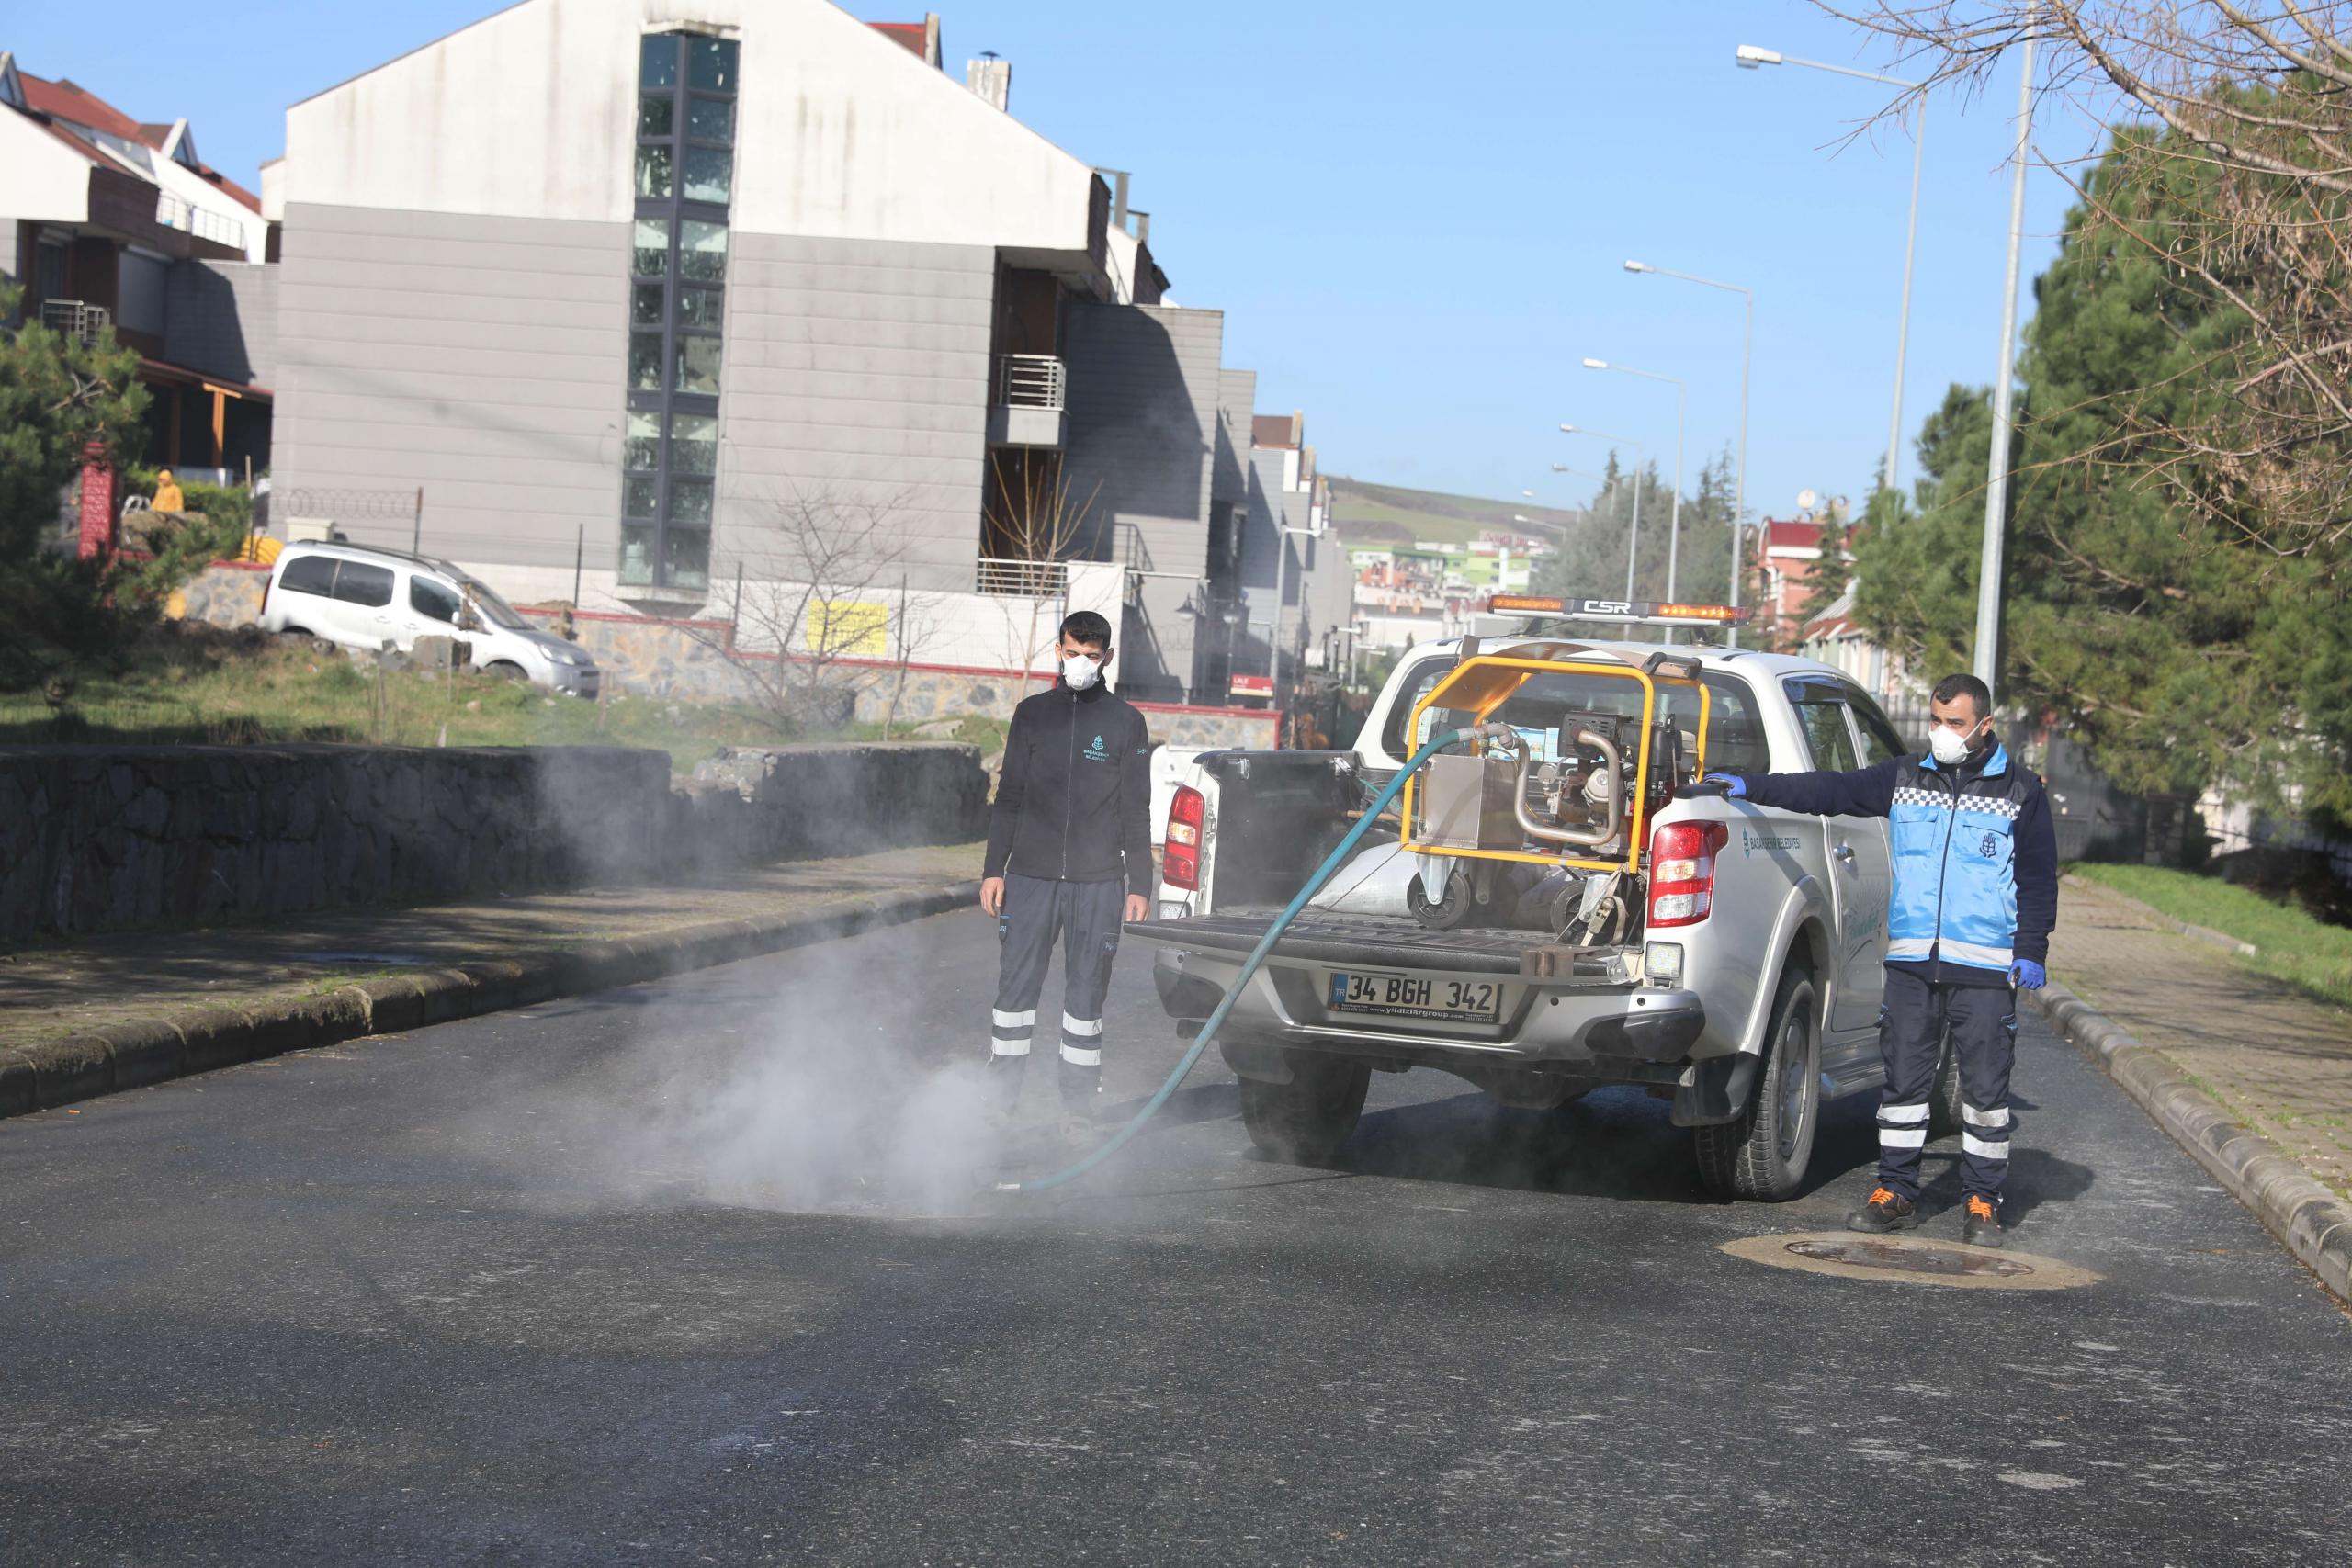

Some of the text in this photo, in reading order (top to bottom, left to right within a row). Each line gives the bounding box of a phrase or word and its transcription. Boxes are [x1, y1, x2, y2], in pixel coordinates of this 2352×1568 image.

[1583, 599, 1631, 615] CSR
[1335, 988, 1345, 997] TR
[1348, 975, 1493, 1011] 34 BGH 342
